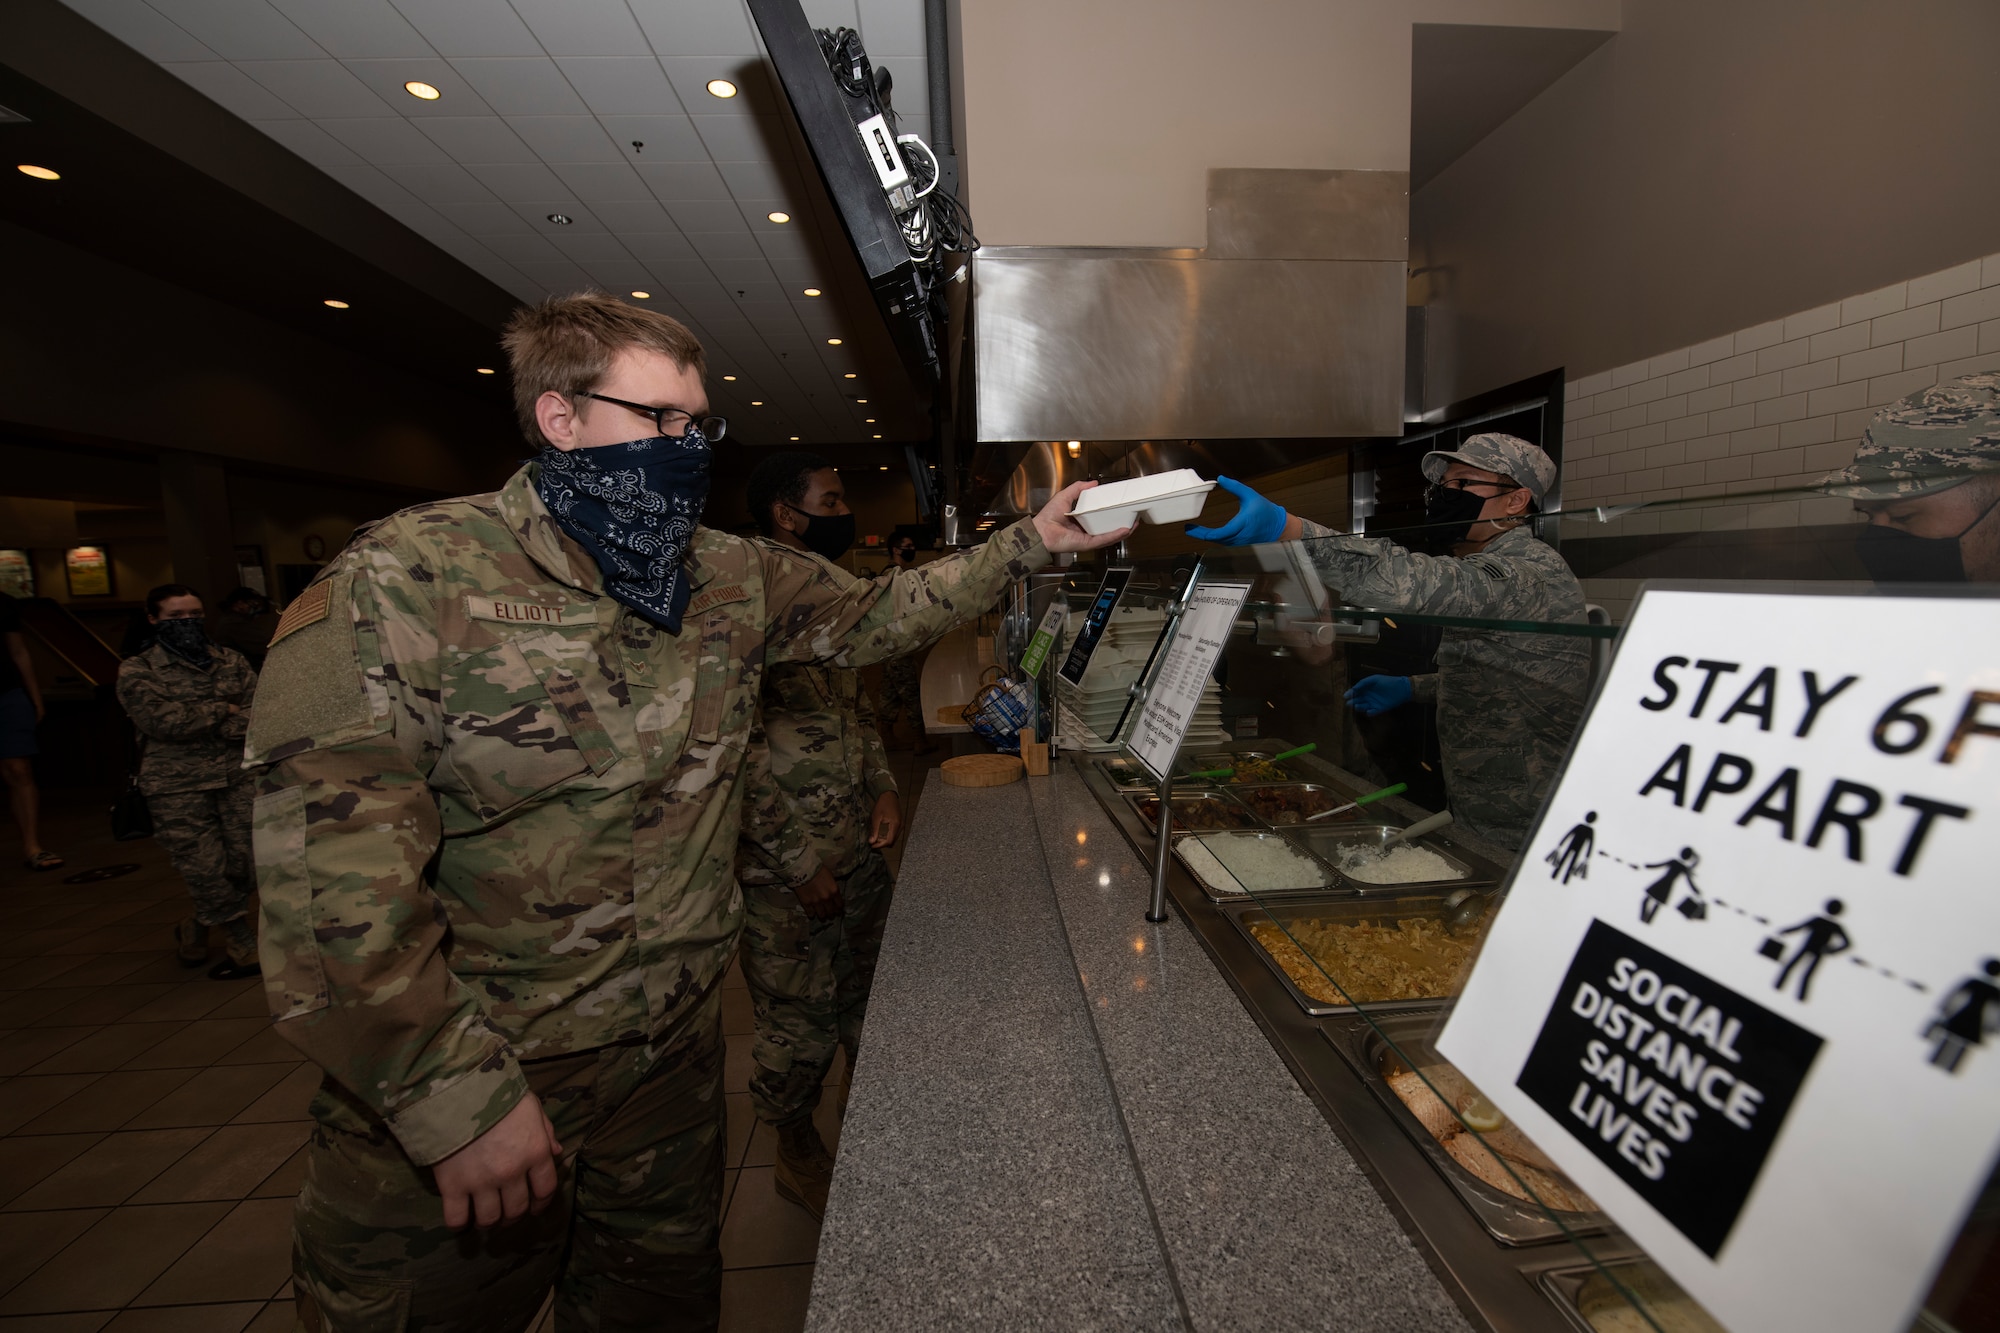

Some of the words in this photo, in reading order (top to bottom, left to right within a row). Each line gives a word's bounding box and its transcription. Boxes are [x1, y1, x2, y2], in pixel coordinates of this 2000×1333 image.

[494, 602, 563, 623] ELLIOTT
[691, 594, 714, 611] AIR
[711, 584, 748, 602] FORCE
[1639, 656, 1859, 738] STAY
[1639, 743, 1972, 878] APART
[1571, 981, 1765, 1131] DISTANCE
[1607, 957, 1743, 1063] SOCIAL
[1569, 1081, 1671, 1181] LIVES
[1580, 1039, 1698, 1143] SAVES
